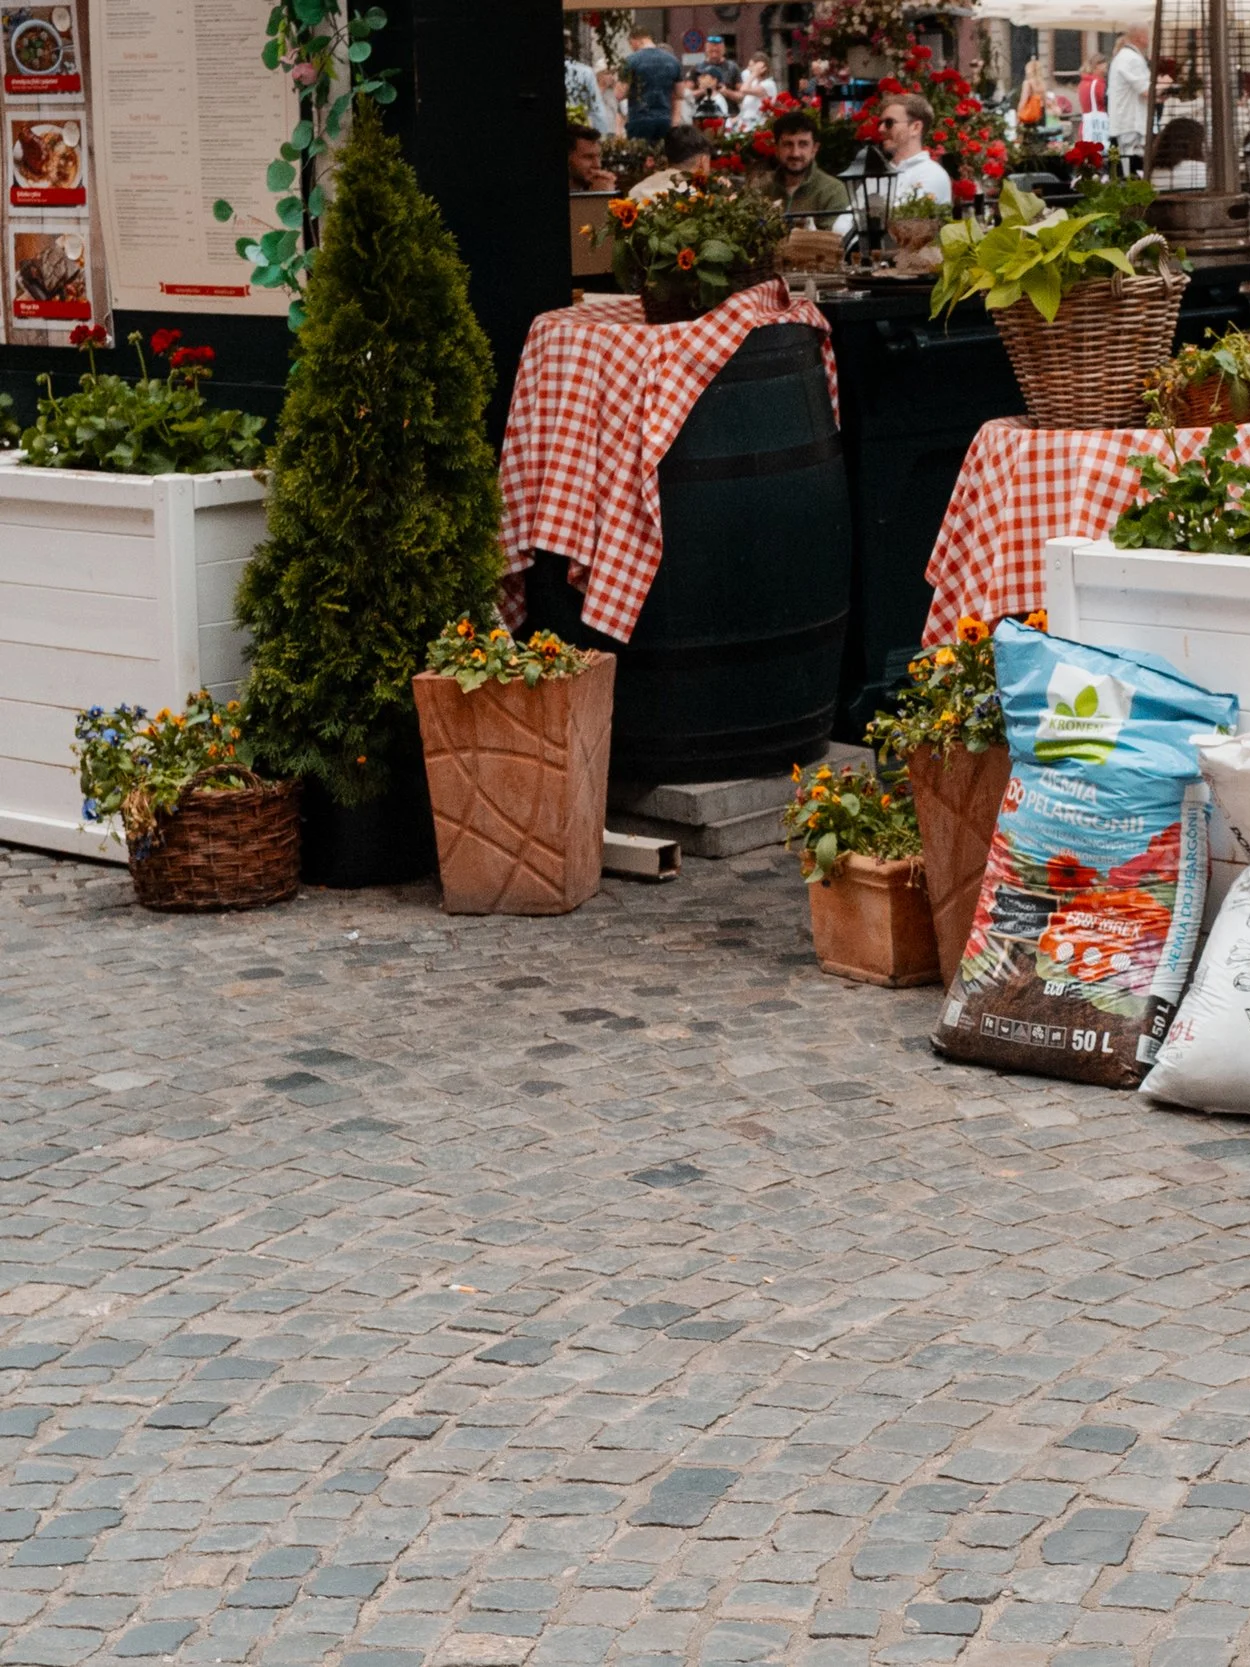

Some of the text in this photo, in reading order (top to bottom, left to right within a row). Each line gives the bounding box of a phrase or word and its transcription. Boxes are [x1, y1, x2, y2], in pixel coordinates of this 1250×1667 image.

[1038, 767, 1098, 804] ZIEMIA
[1007, 780, 1025, 804] DO
[1026, 790, 1145, 834] PELARGONII
[1181, 893, 1194, 917] DO
[1043, 981, 1065, 996] ECO
[1151, 1004, 1171, 1038] 50 L
[1071, 1029, 1114, 1054] 50 L
